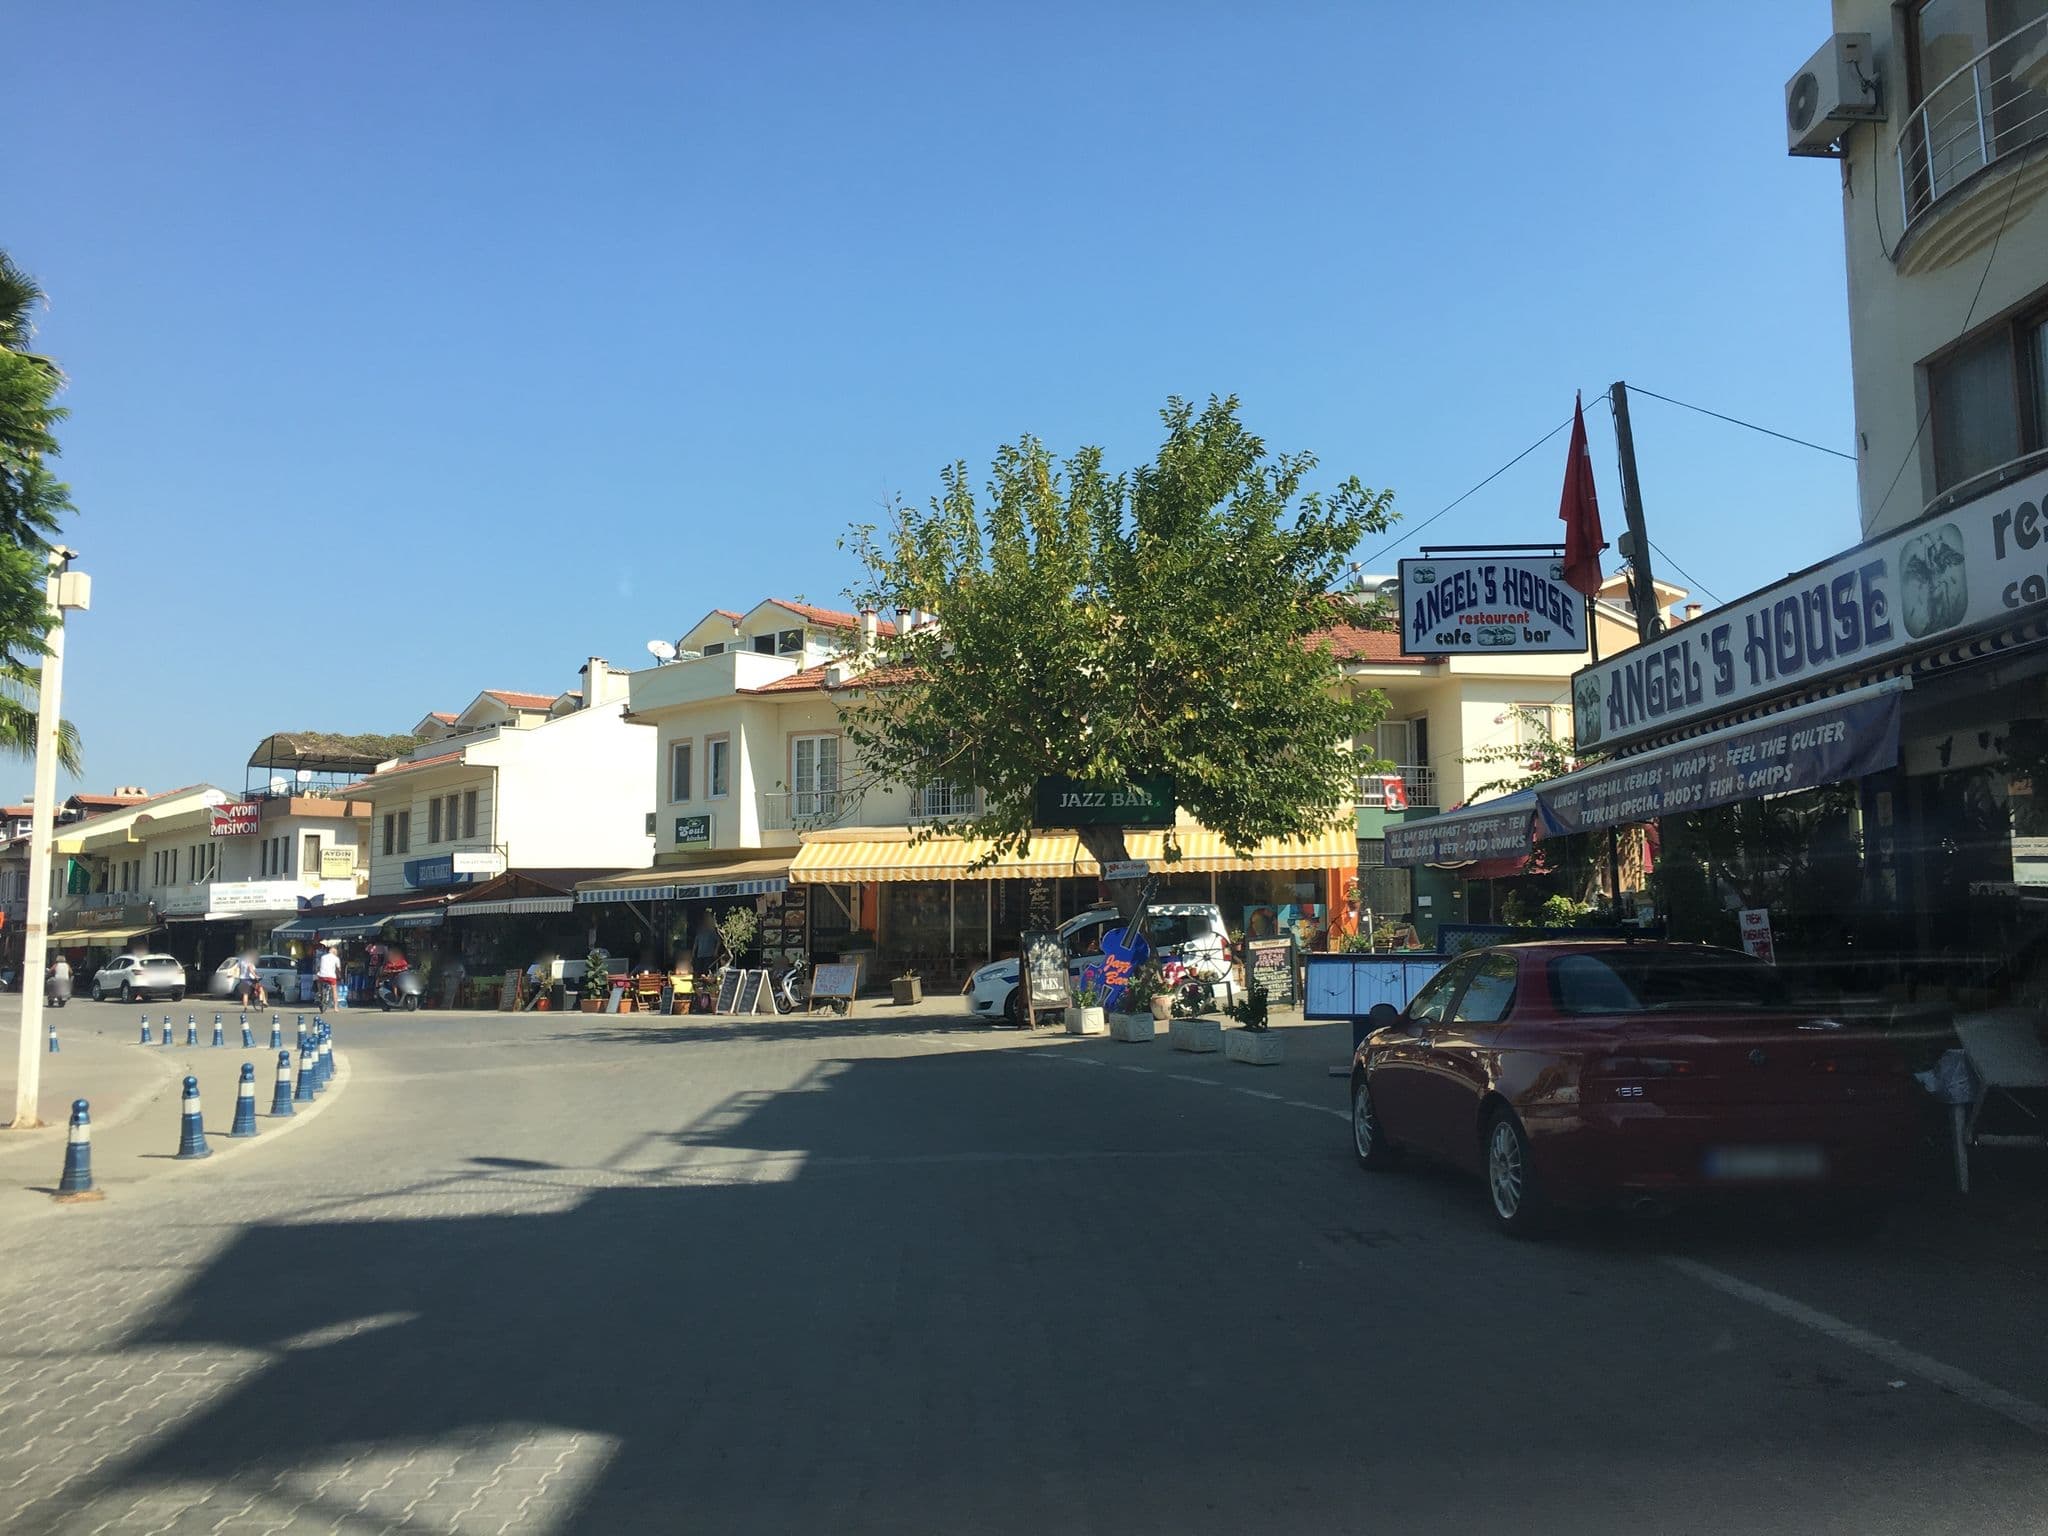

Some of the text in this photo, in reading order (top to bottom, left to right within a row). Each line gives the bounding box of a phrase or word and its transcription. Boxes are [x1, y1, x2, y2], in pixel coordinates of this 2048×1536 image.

[2002, 564, 2048, 608] ca
[1413, 566, 1576, 644] ANGEL'S HOUSE
[1458, 610, 1530, 624] restaurant
[1435, 627, 1551, 645] cafe bar
[1606, 558, 1894, 732] ANGEL'S HOUSE
[1553, 720, 1845, 809] LUNCH SPECIAL KEBABS WRAP'S FEEL THE CULTER
[1059, 792, 1154, 808] JAZZ BAR
[1581, 763, 1794, 825] TURKISH SPECIAL FOOD'S FISH & CHIPS
[229, 804, 258, 818] AYDIN
[678, 824, 705, 837] Soul
[1467, 819, 1500, 834] COFFEE
[1508, 815, 1526, 830] TEA
[1464, 839, 1488, 853] COLD
[1490, 834, 1526, 850] DRINKS
[1103, 954, 1133, 974] Jazz
